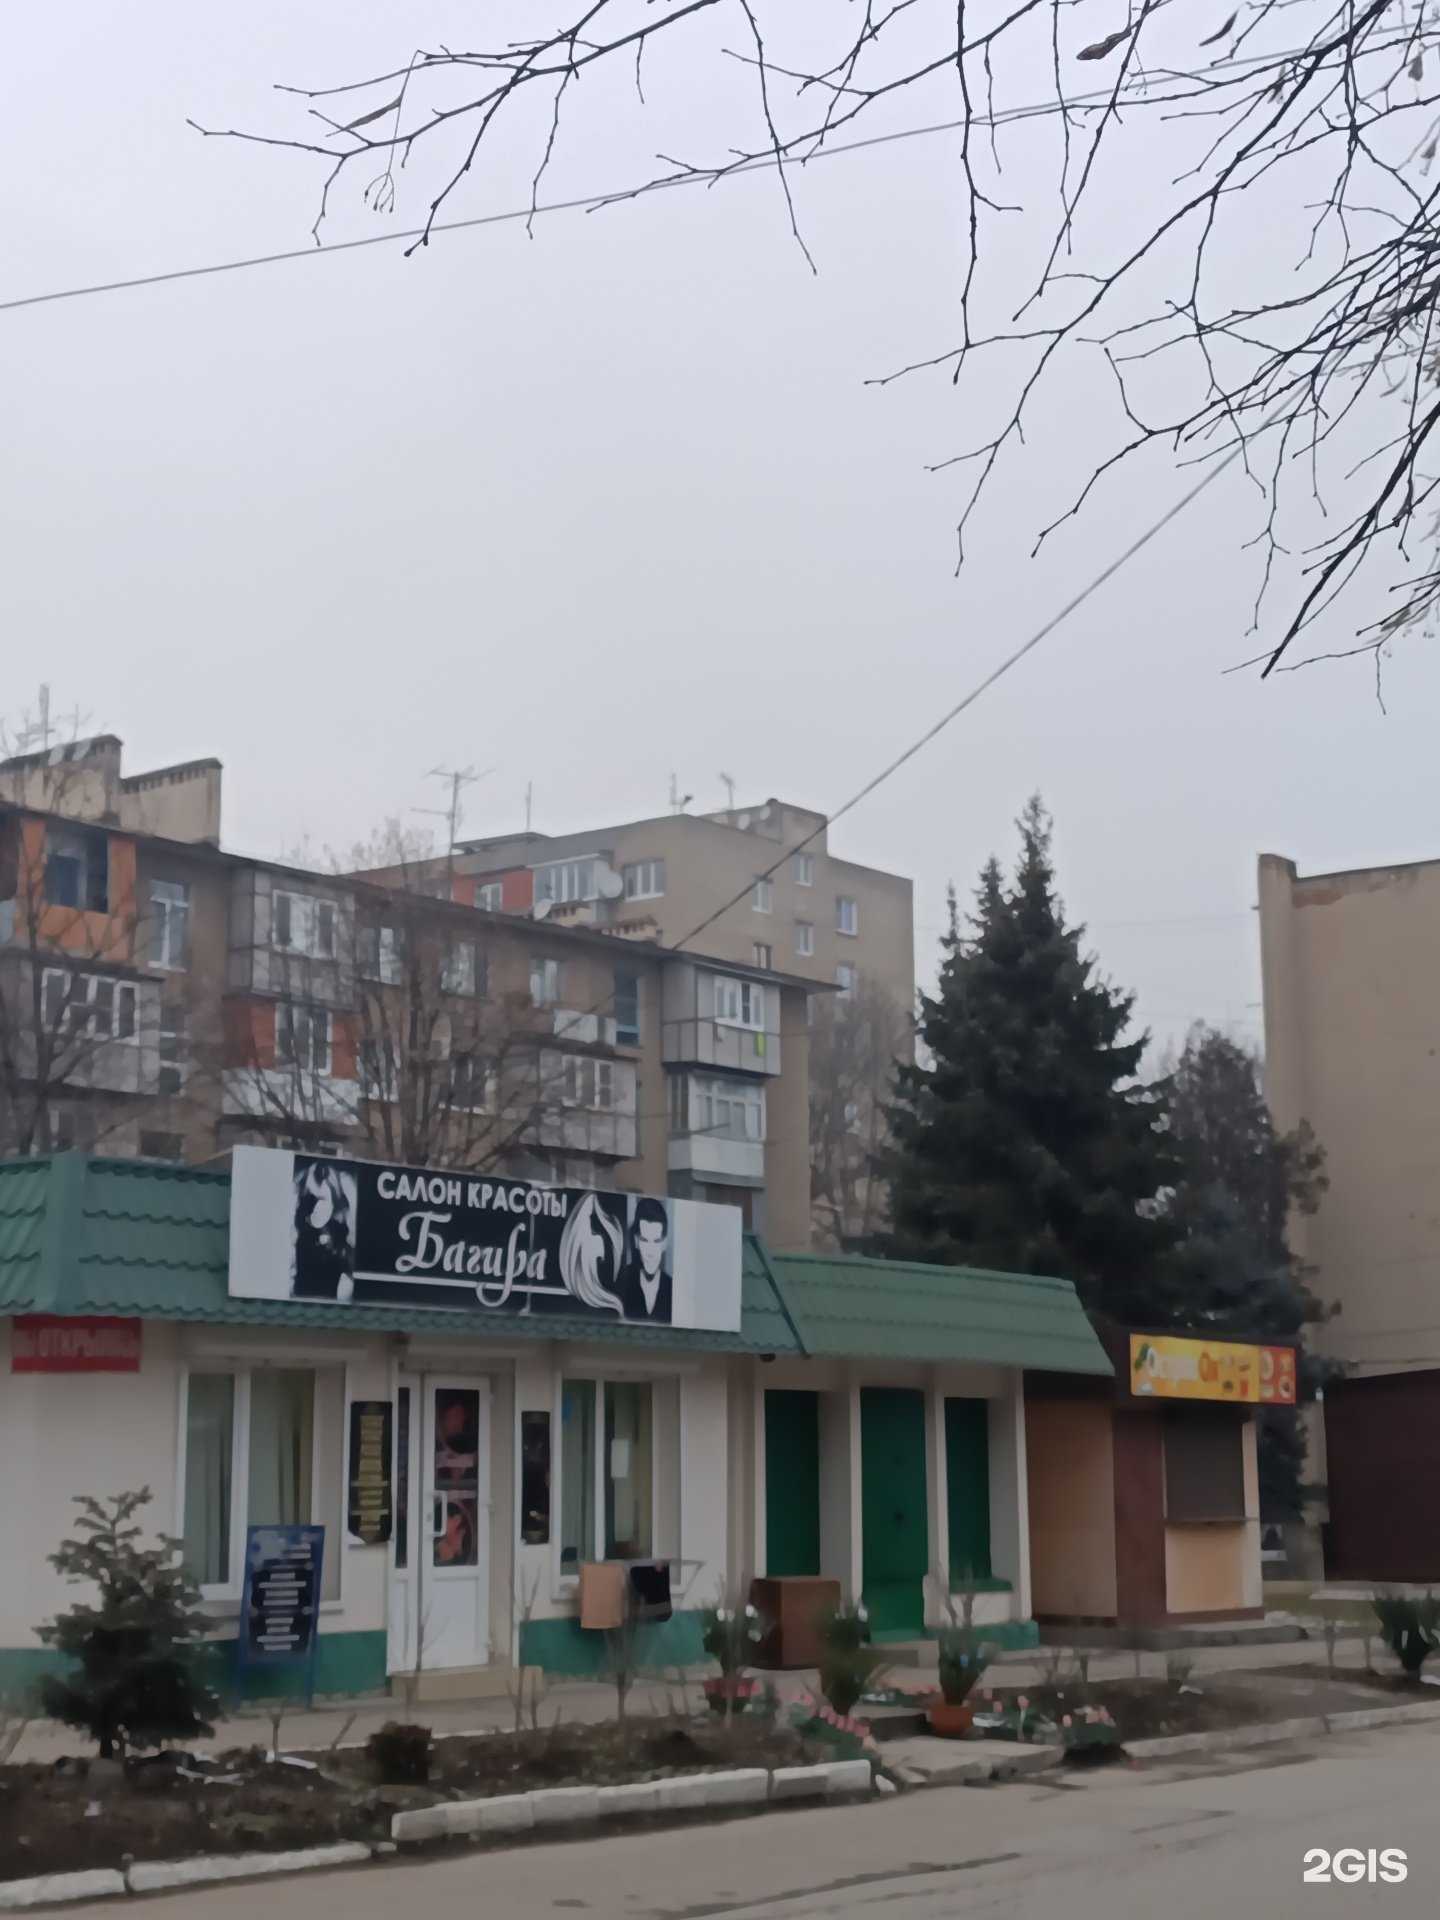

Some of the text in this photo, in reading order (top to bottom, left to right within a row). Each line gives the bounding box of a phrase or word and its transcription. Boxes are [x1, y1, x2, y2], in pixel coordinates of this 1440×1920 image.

[377, 1171, 567, 1218] САЛОН КРАСОТЫ
[395, 1211, 547, 1307] Багира
